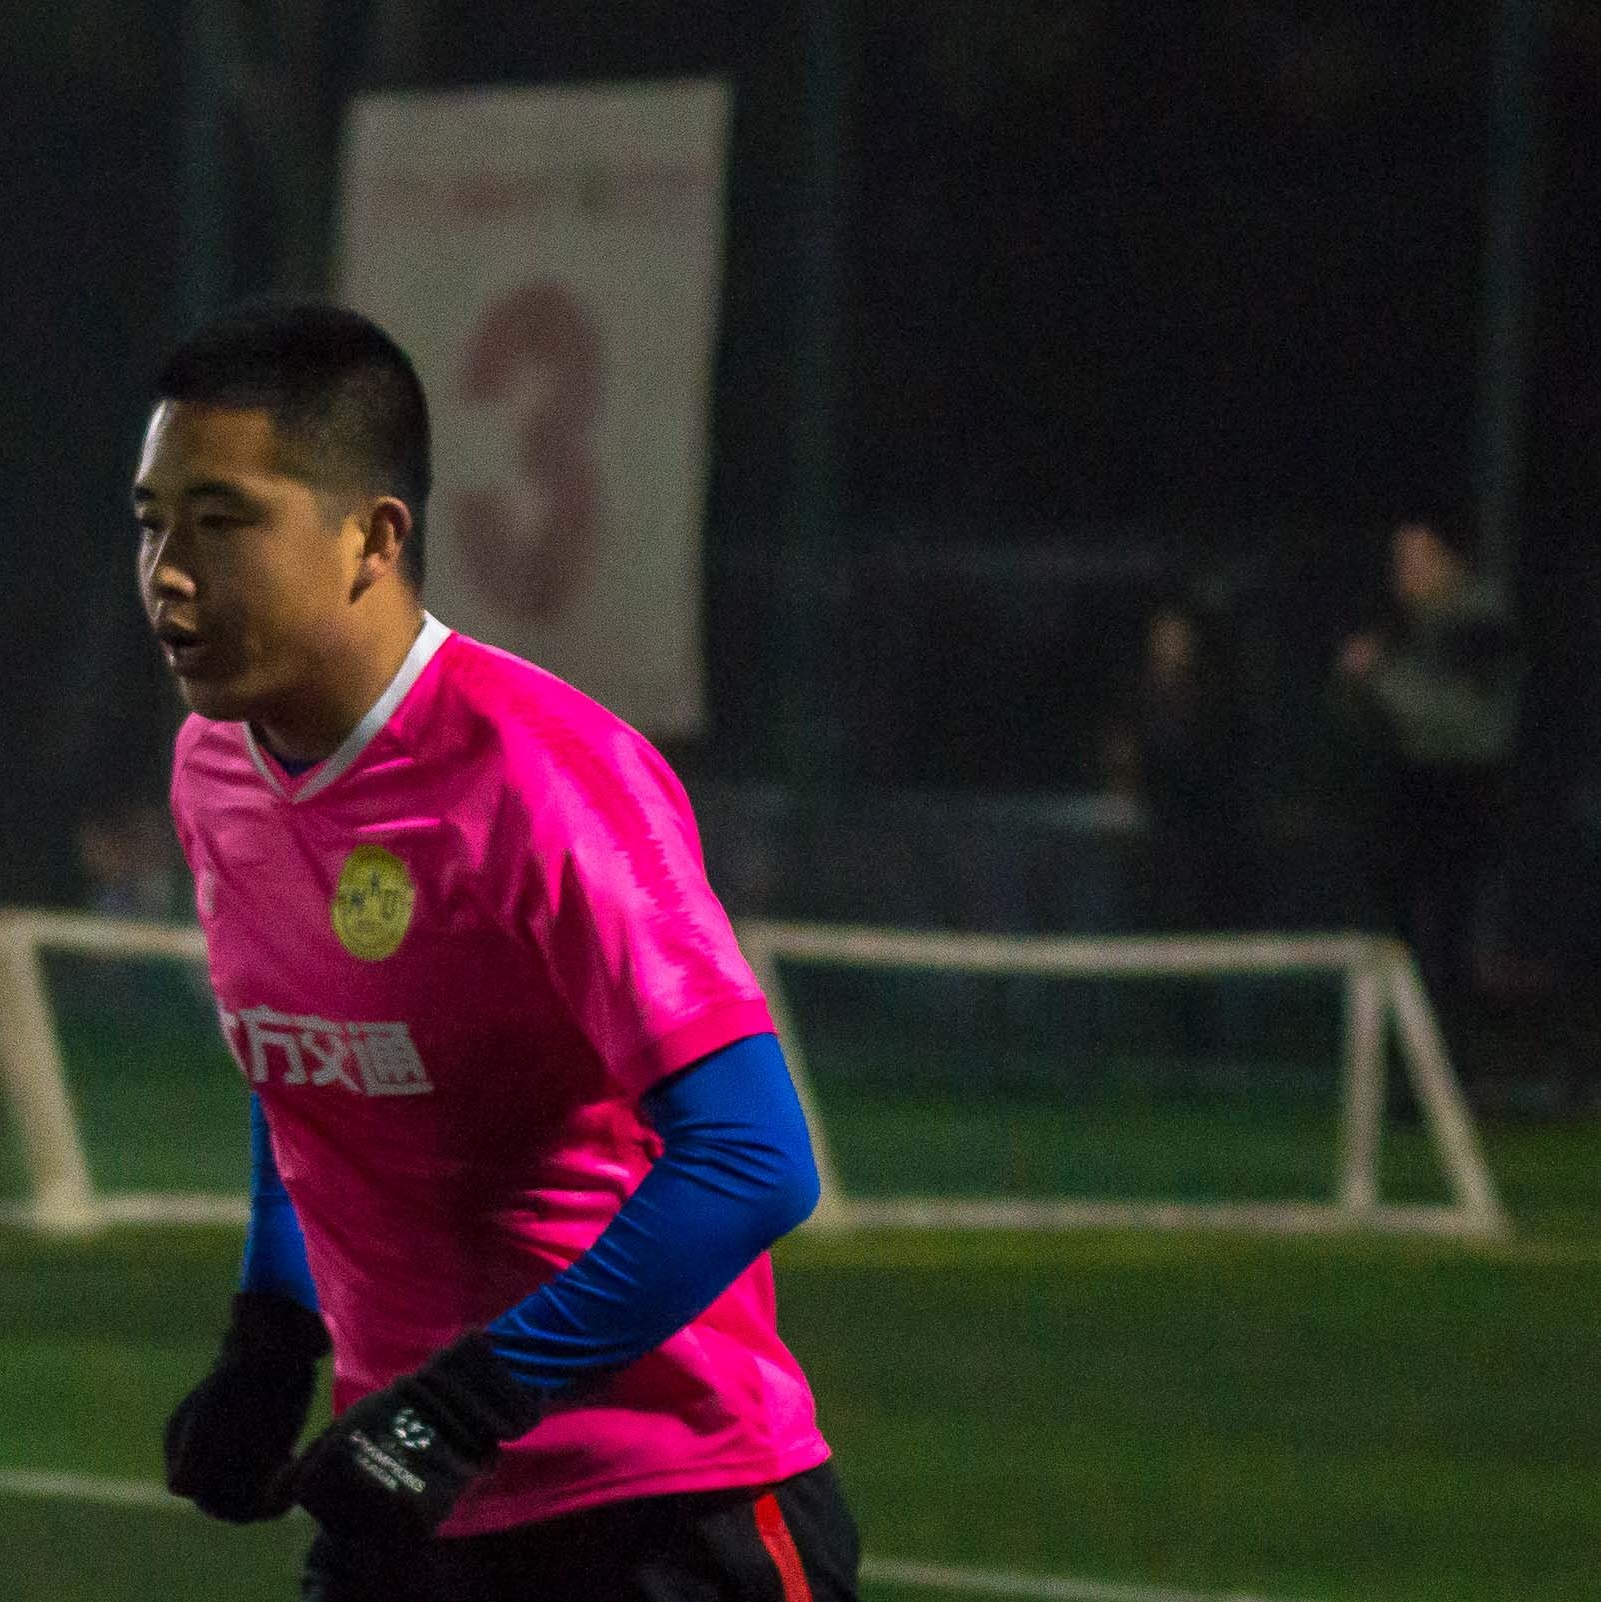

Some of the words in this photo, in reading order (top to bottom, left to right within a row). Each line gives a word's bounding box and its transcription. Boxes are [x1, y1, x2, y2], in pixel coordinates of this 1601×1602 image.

[453, 281, 603, 620] 3
[221, 1004, 435, 1097] 方交通
